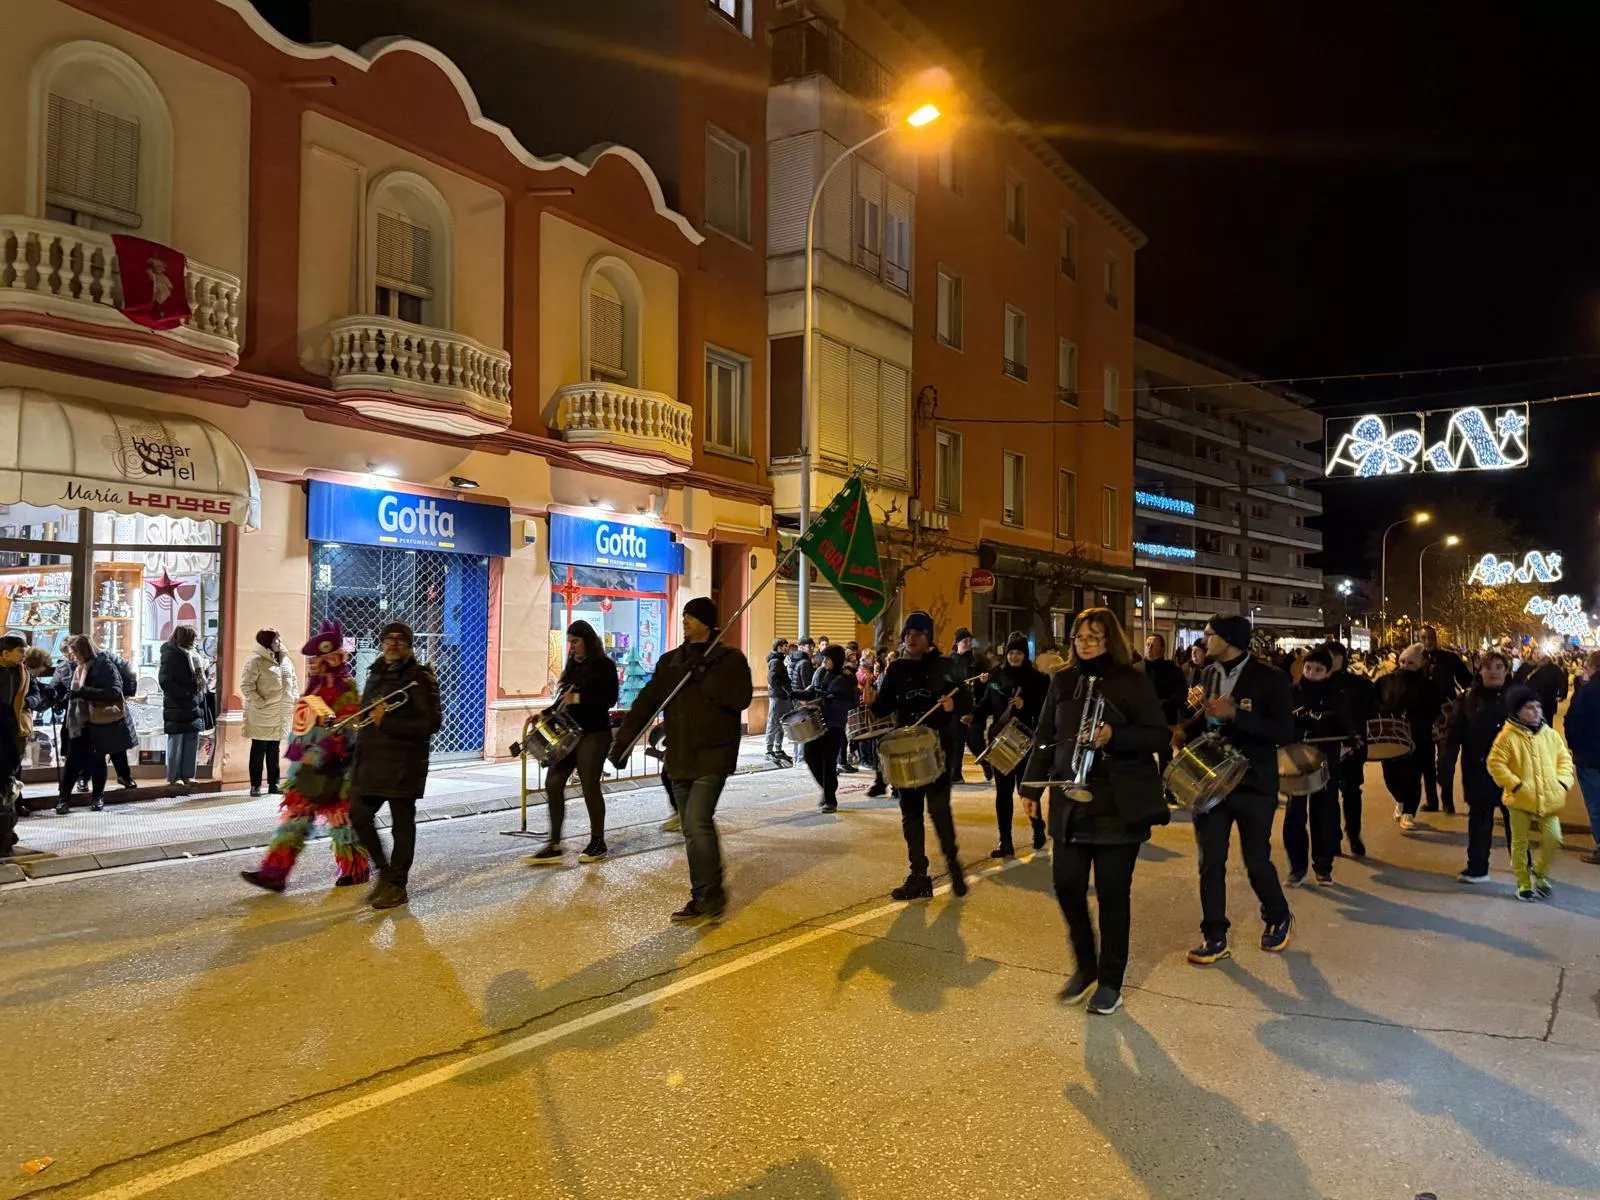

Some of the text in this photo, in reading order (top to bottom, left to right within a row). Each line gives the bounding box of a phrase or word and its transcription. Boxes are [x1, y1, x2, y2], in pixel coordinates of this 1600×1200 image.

[131, 436, 191, 461] Hogar
[157, 457, 195, 481] Piel
[58, 481, 123, 504] María
[377, 494, 455, 538] Gotta
[595, 524, 647, 559] Gotta
